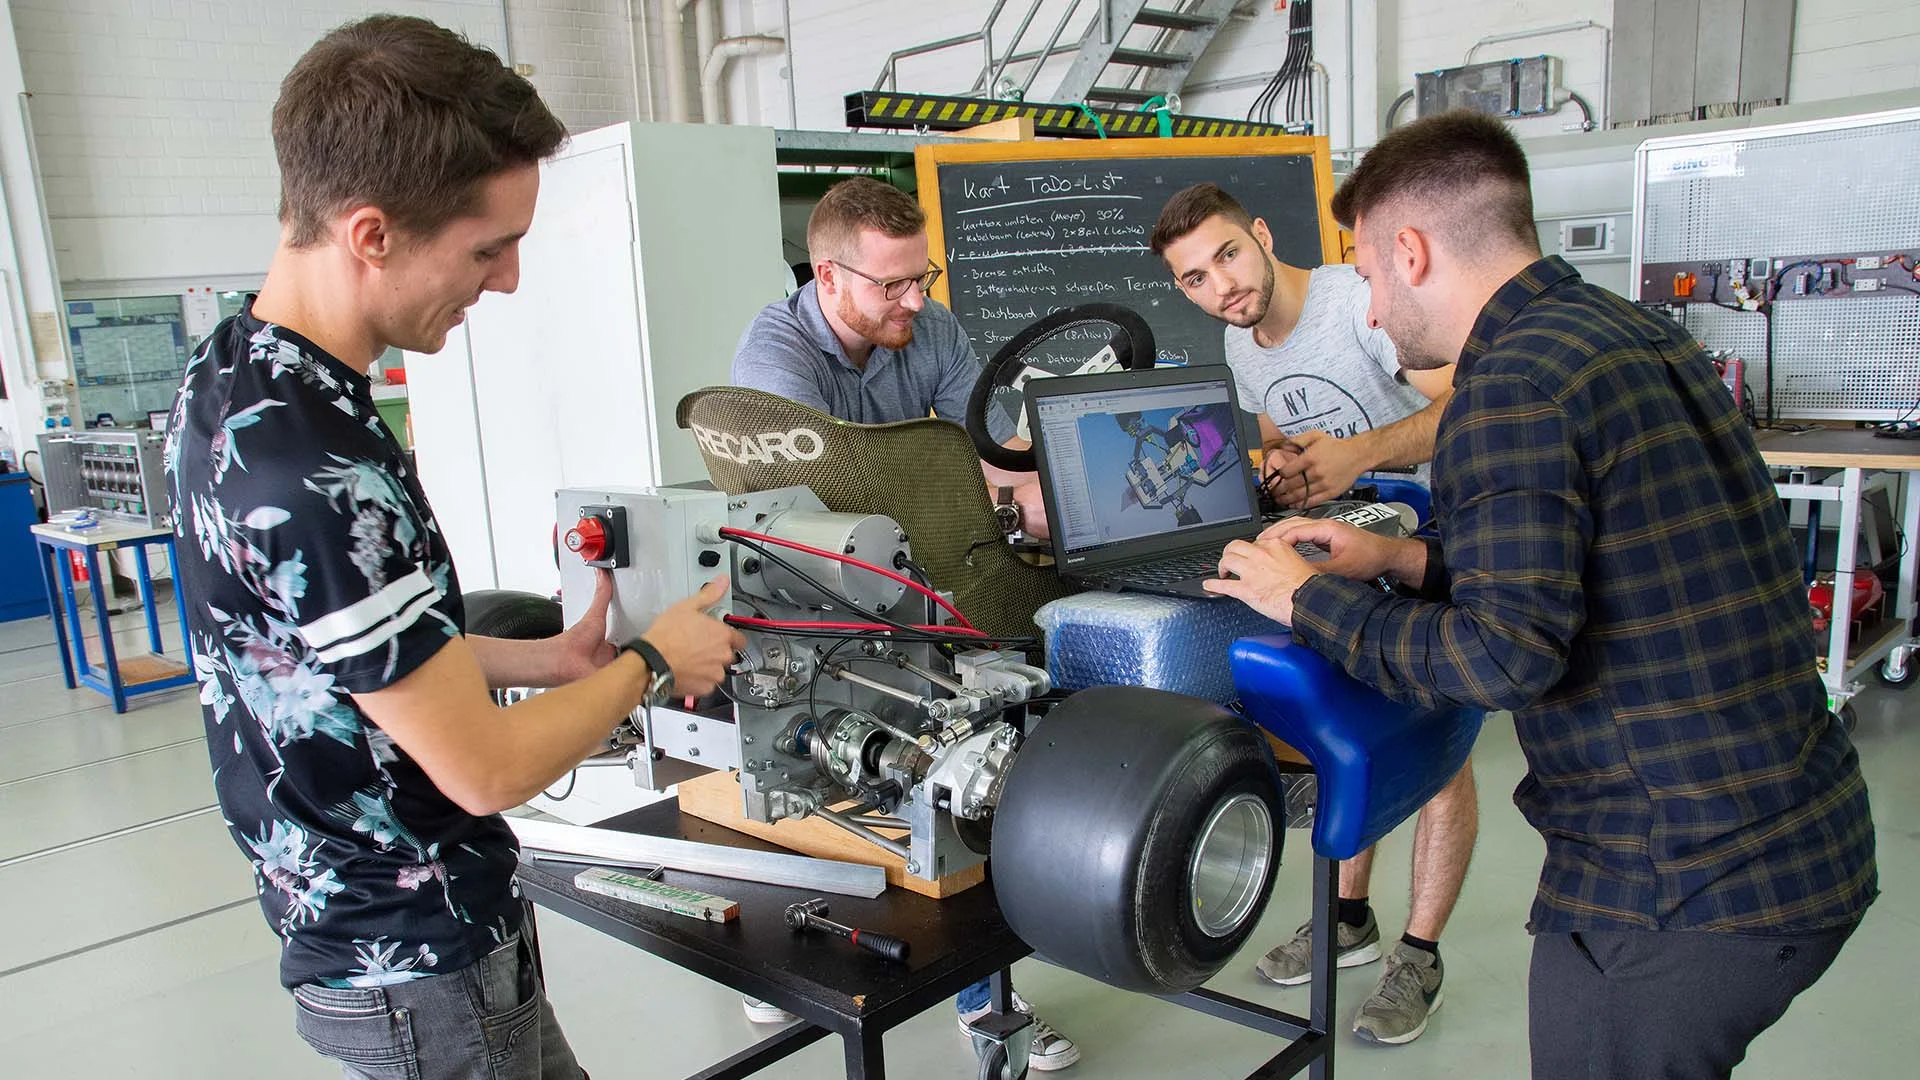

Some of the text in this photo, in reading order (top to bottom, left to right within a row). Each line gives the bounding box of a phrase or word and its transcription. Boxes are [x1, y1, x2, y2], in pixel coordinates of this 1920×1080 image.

[964, 175, 1010, 199] Kart
[1096, 208, 1124, 221] 90%
[971, 268, 1008, 280] Bremse
[980, 304, 1037, 319] Dashboard
[1282, 387, 1311, 417] NY
[691, 422, 825, 465] RECARO
